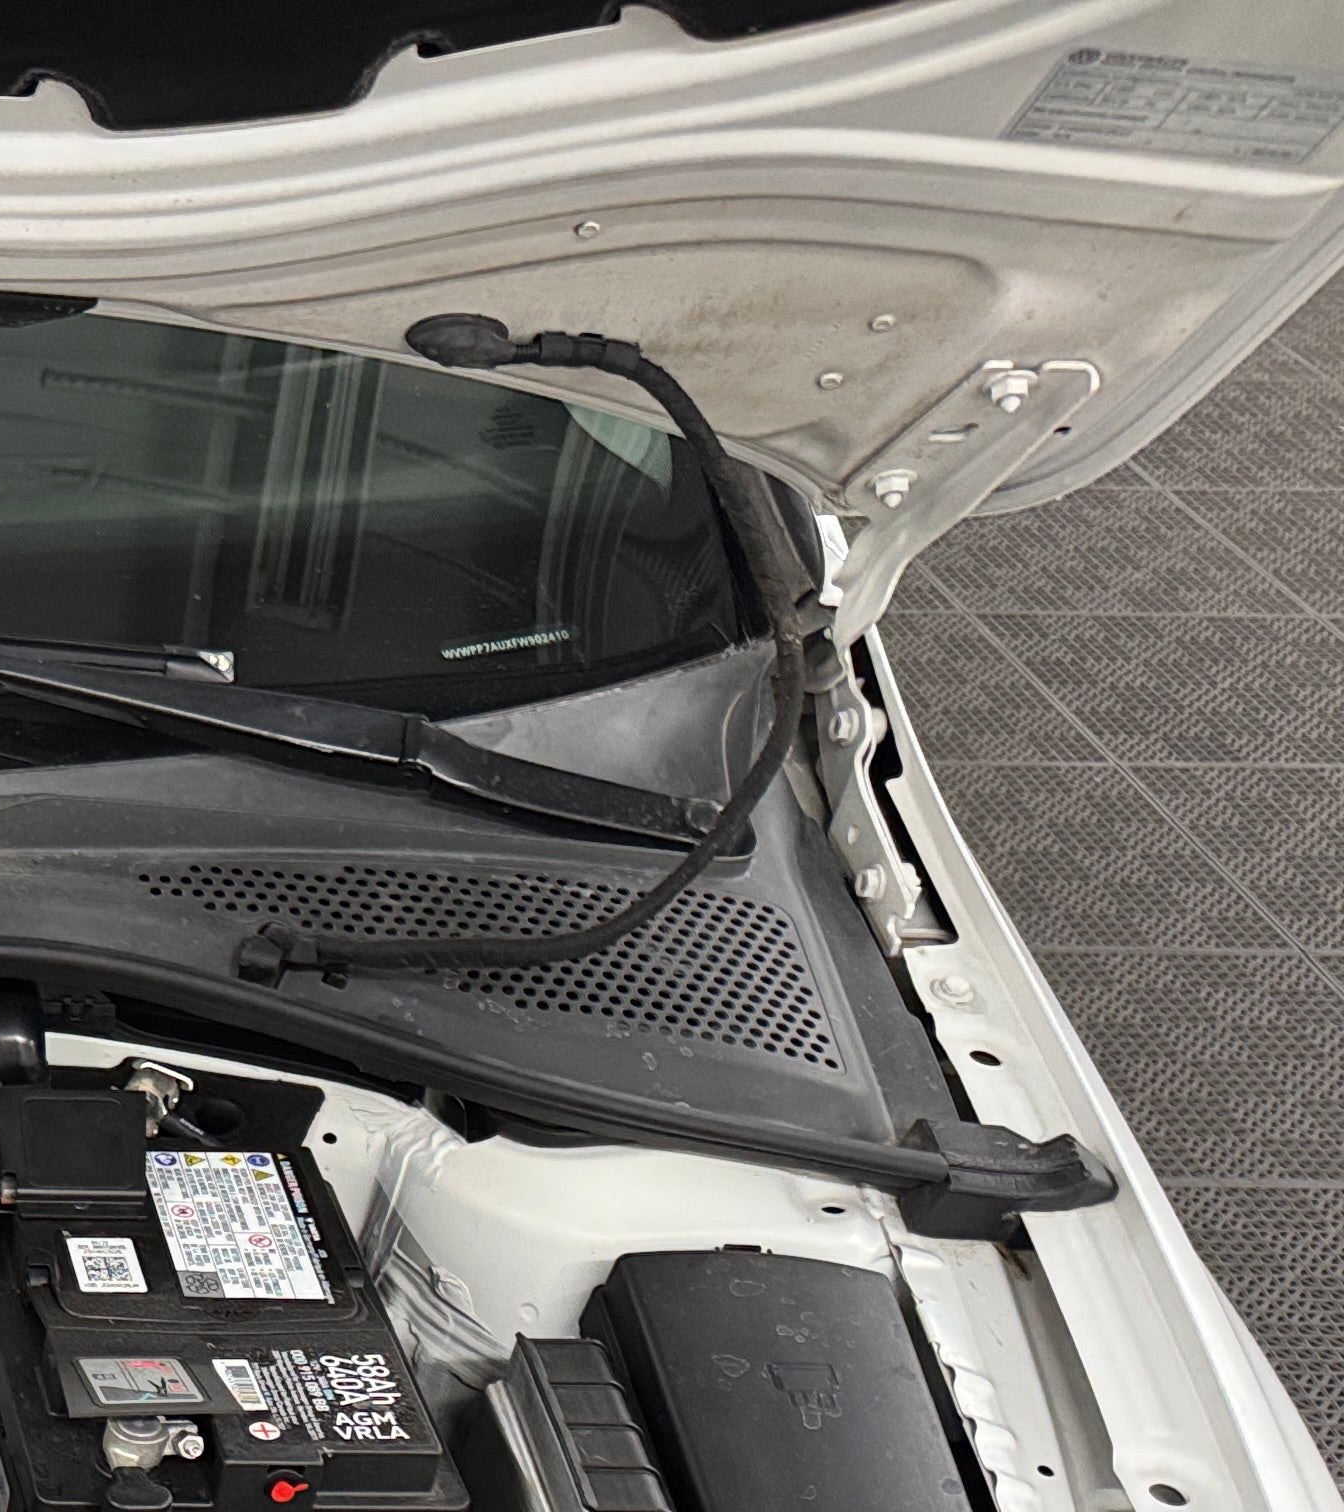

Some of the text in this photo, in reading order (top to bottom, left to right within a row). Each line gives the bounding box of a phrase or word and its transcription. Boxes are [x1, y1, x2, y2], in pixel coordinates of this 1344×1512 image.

[319, 1355, 370, 1406] 640A
[351, 1353, 402, 1406] 58Ah
[333, 1425, 411, 1441] VRLA
[335, 1411, 398, 1426] AGM
